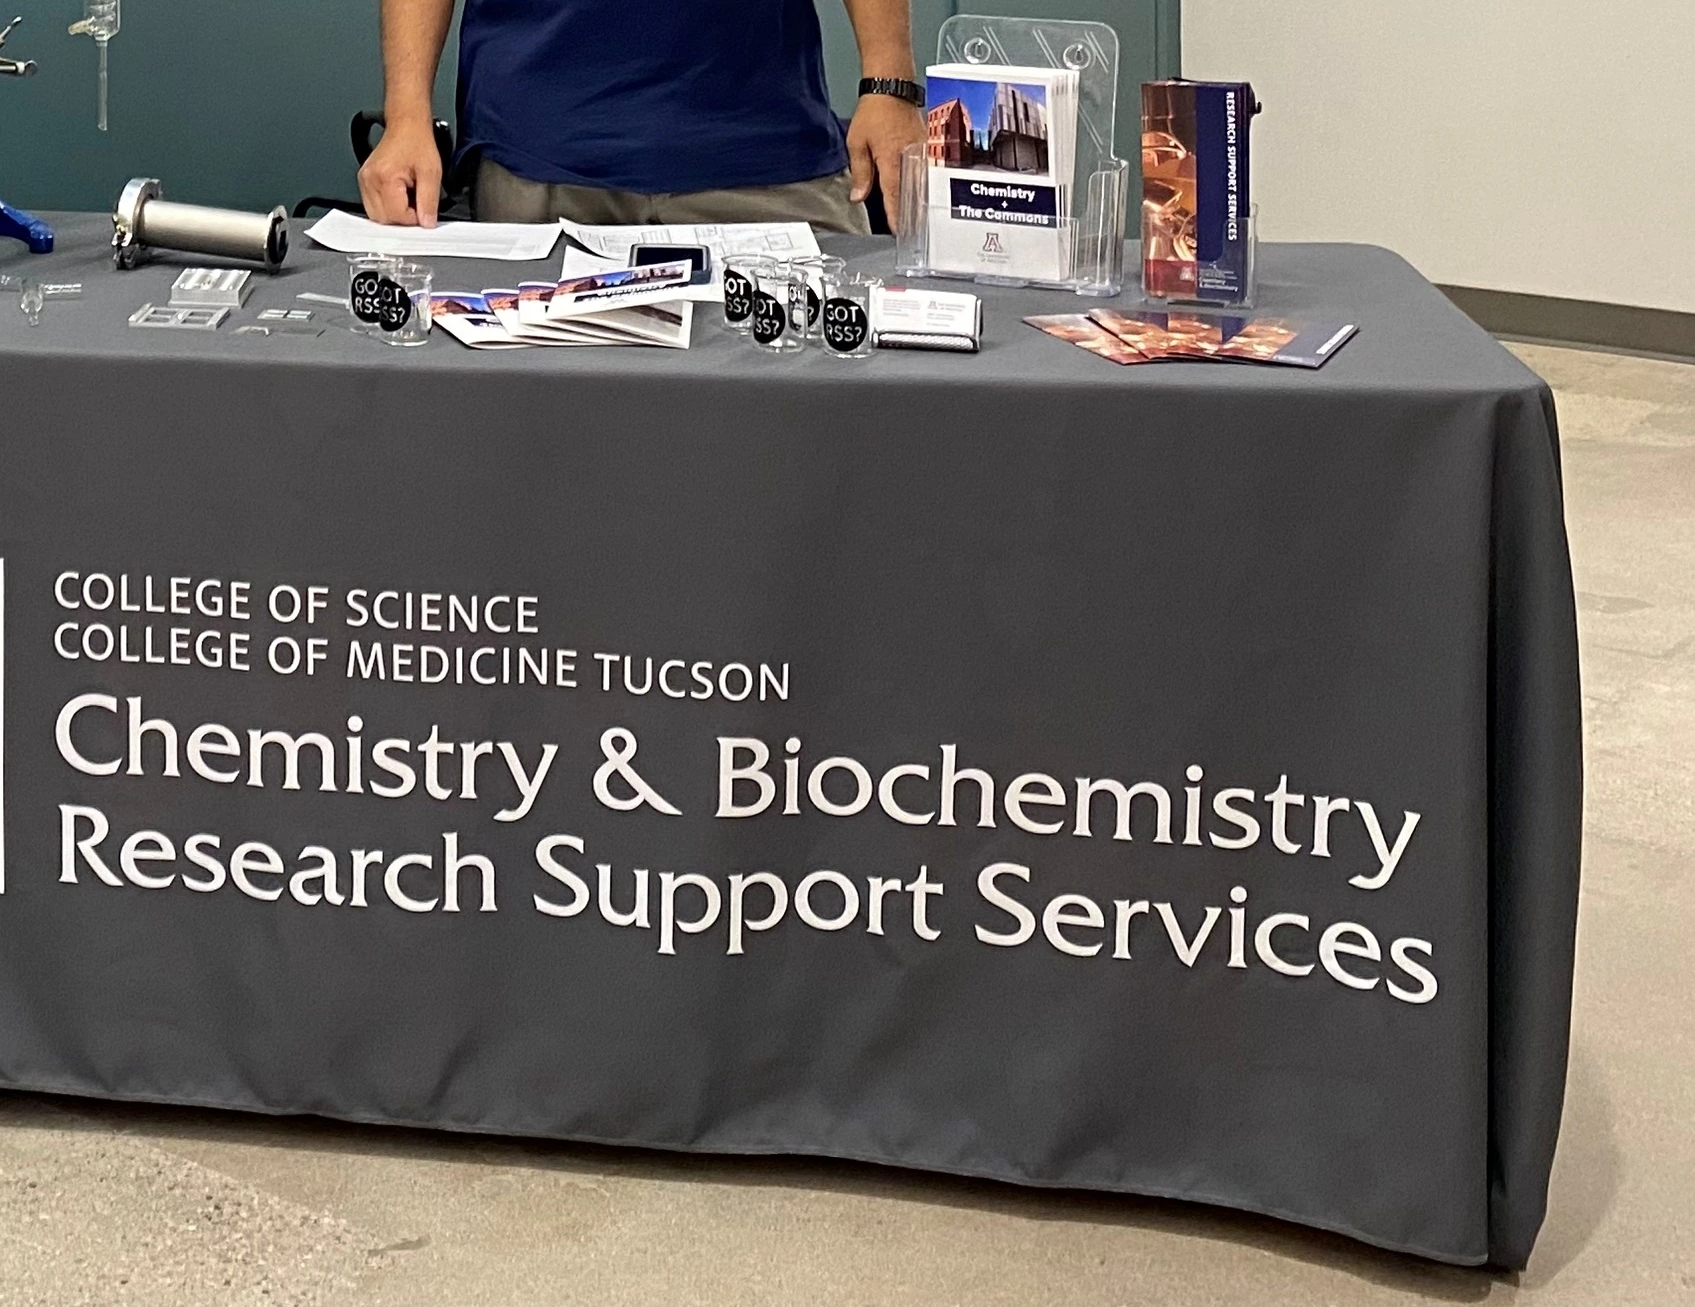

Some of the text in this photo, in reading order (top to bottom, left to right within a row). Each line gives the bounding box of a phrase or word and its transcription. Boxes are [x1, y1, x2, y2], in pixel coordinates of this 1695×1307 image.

[1226, 92, 1238, 241] RESEARCH SUPPORT SERVICES
[971, 183, 1035, 201] Chemistry
[959, 205, 1049, 225] The Commons
[355, 278, 379, 295] GO
[381, 286, 402, 304] OT
[725, 278, 747, 296] OT
[355, 296, 381, 314] RSS
[381, 305, 406, 323] SS?
[727, 298, 750, 315] SS?
[757, 299, 776, 316] OT
[826, 304, 859, 323] GOT
[755, 319, 780, 335] SS?
[826, 326, 862, 343] RSS?
[54, 571, 539, 634] COLLEGE OF SCIENCE
[54, 622, 790, 702] COLLEGE OF MEDICINE TUCSON
[53, 693, 1421, 891] Chemistry & Biochemistry
[58, 802, 1439, 1005] Research Support Services
